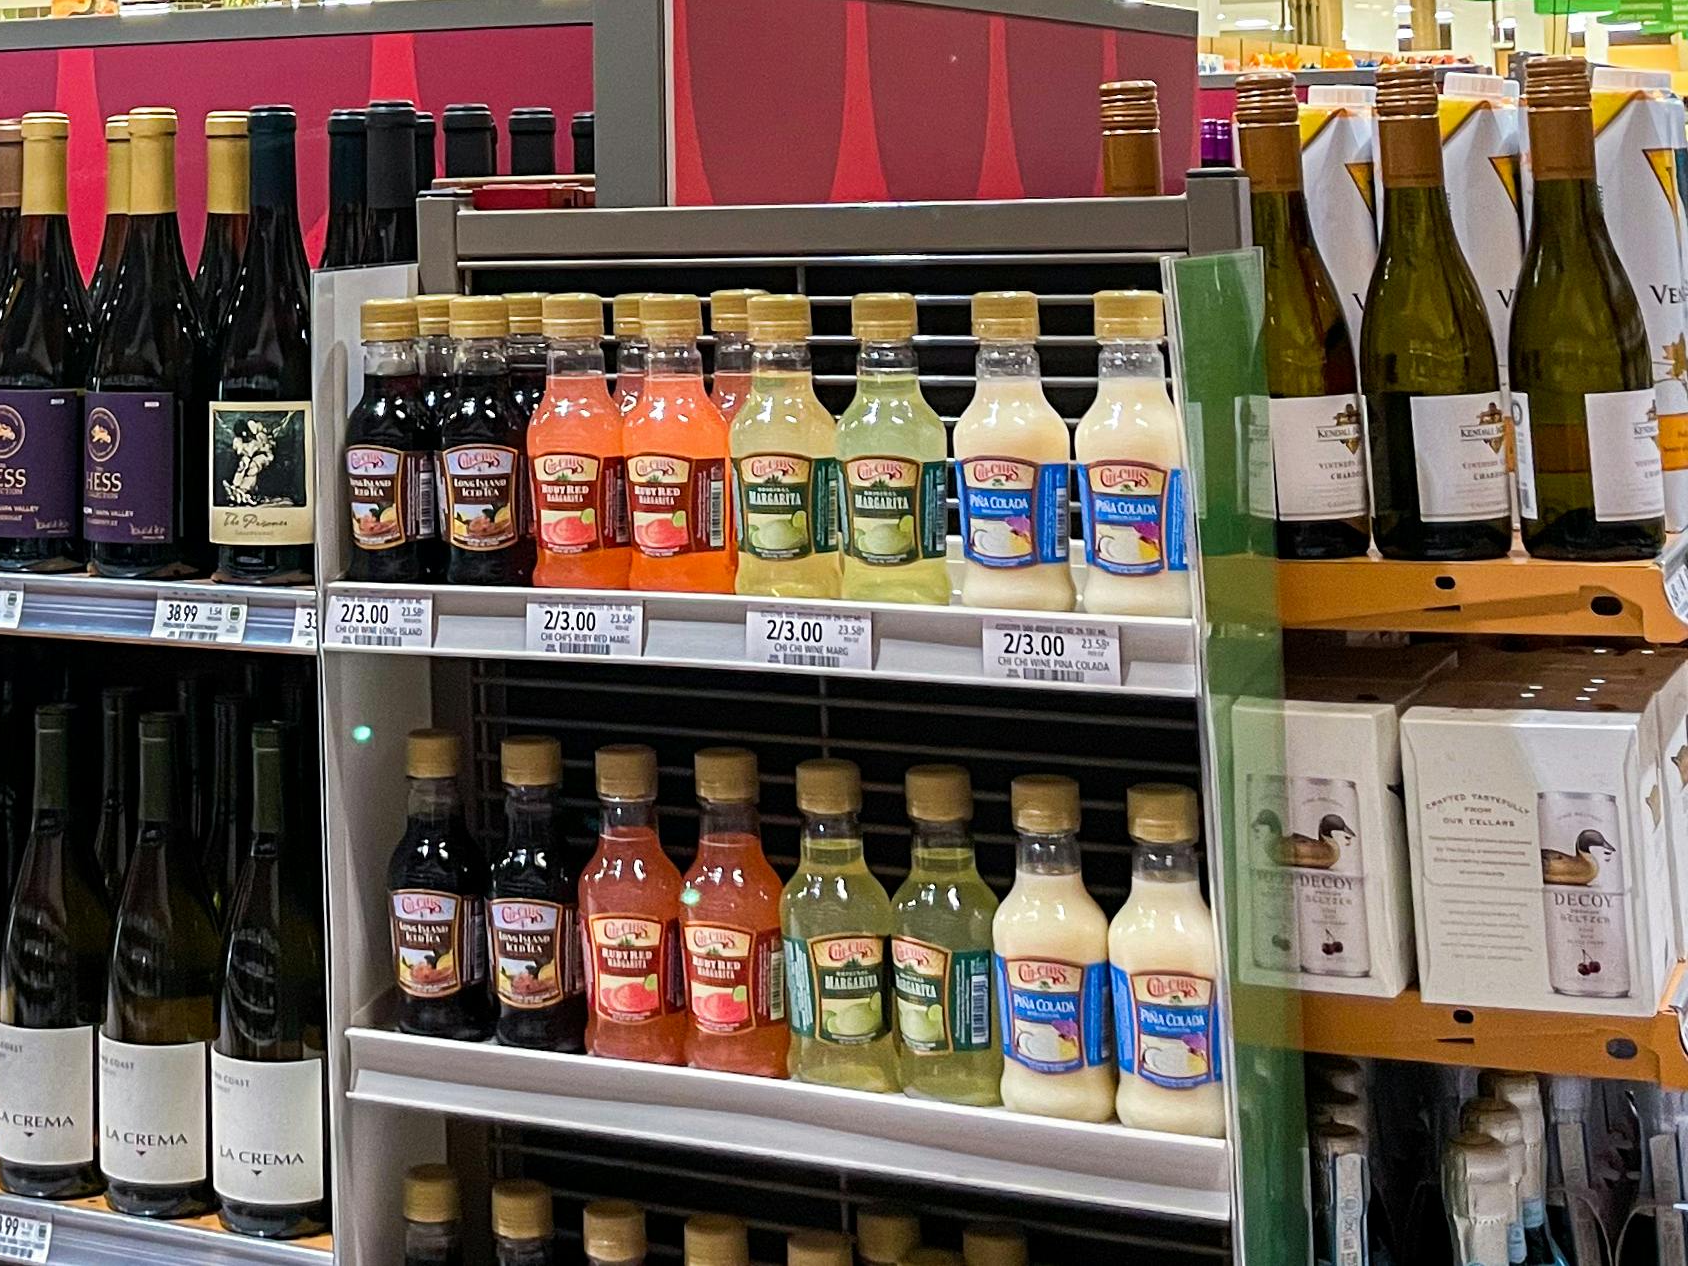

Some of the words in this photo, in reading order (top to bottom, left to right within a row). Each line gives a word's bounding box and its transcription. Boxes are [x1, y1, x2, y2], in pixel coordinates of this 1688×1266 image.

[86, 472, 123, 493] HESS
[453, 478, 475, 487] LONG
[475, 478, 507, 487] ISLAND
[541, 484, 565, 495] RUBY
[566, 484, 590, 494] RED
[634, 485, 657, 496] RUBY
[657, 486, 681, 497] RED
[749, 491, 802, 506] MARGARITA
[13, 505, 40, 514] VALLEY
[855, 495, 910, 510] MARGARITA
[970, 493, 990, 508] PIÑA
[990, 496, 1029, 510] COLADA
[1095, 499, 1117, 514] PIÑA
[1117, 502, 1157, 516] COLADA
[110, 510, 134, 518] VALLEY
[223, 511, 240, 527] The
[242, 515, 289, 530] Prisoner
[167, 603, 199, 623] 38.99
[340, 603, 389, 624] 2/3.00
[544, 610, 596, 631] 2/3.00
[379, 626, 398, 636] LONG
[399, 627, 423, 637] ISLAND
[574, 633, 593, 643] RUBY
[593, 634, 608, 644] RED
[766, 619, 823, 643] 2/3.00
[774, 642, 788, 652] CHI
[789, 643, 803, 653] CHI
[804, 644, 824, 655] WINE
[826, 645, 849, 656] MARG
[1003, 633, 1065, 657] 2/3.00
[998, 656, 1012, 666] CHI
[1014, 657, 1028, 667] CHI
[1031, 657, 1052, 668] WINE
[1053, 659, 1073, 669] PINA
[1075, 660, 1110, 672] COLADA
[1425, 792, 1467, 811] CRAFTED
[1471, 792, 1530, 815] TASTEFULLY
[1464, 806, 1492, 814] FROM
[1443, 817, 1464, 826] OUR
[1469, 818, 1516, 827] CELLARS
[1299, 874, 1355, 890] DECOY
[1554, 892, 1614, 909] DECOY
[1560, 915, 1611, 924] SELTZER
[601, 947, 629, 959] RUBY
[629, 949, 653, 960] RED
[692, 955, 716, 967] RUBY
[716, 959, 741, 970] RED
[824, 974, 878, 990] MARGARITA
[1014, 993, 1035, 1010] PIÑA
[1036, 998, 1075, 1012] COLADA
[1140, 1007, 1164, 1026] PIÑA
[1165, 1013, 1205, 1027] COLADA
[110, 1058, 134, 1071] COAST
[223, 1073, 250, 1088] COAST
[12, 1112, 75, 1129] CREMA
[105, 1125, 121, 1142] LA
[123, 1131, 188, 1147] CREMA
[219, 1144, 235, 1161] LA
[238, 1151, 305, 1167] CREMA
